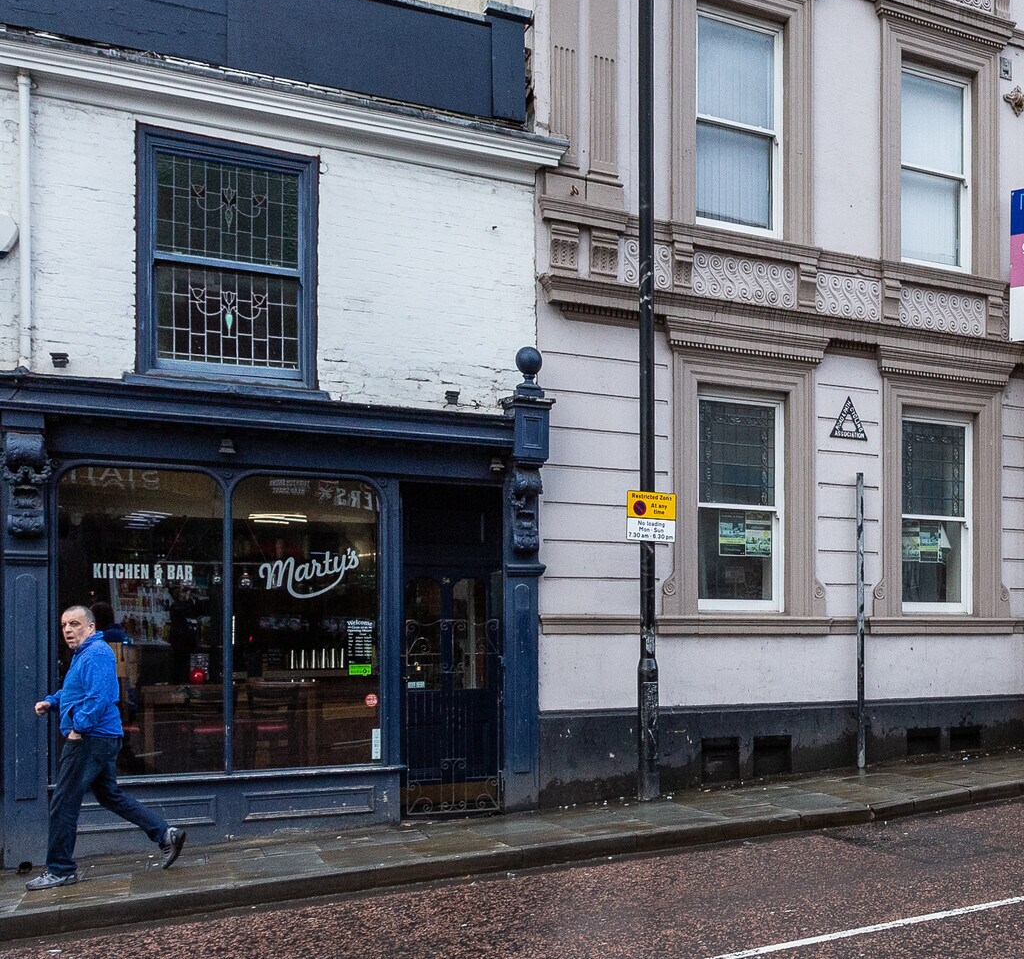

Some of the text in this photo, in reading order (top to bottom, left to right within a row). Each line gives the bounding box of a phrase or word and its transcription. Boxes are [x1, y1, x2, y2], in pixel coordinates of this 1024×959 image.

[834, 430, 865, 439] ASSOCIATION
[631, 492, 659, 501] Restricted
[93, 562, 193, 581] KITCHEN & BAR
[258, 547, 359, 599] Marty's
